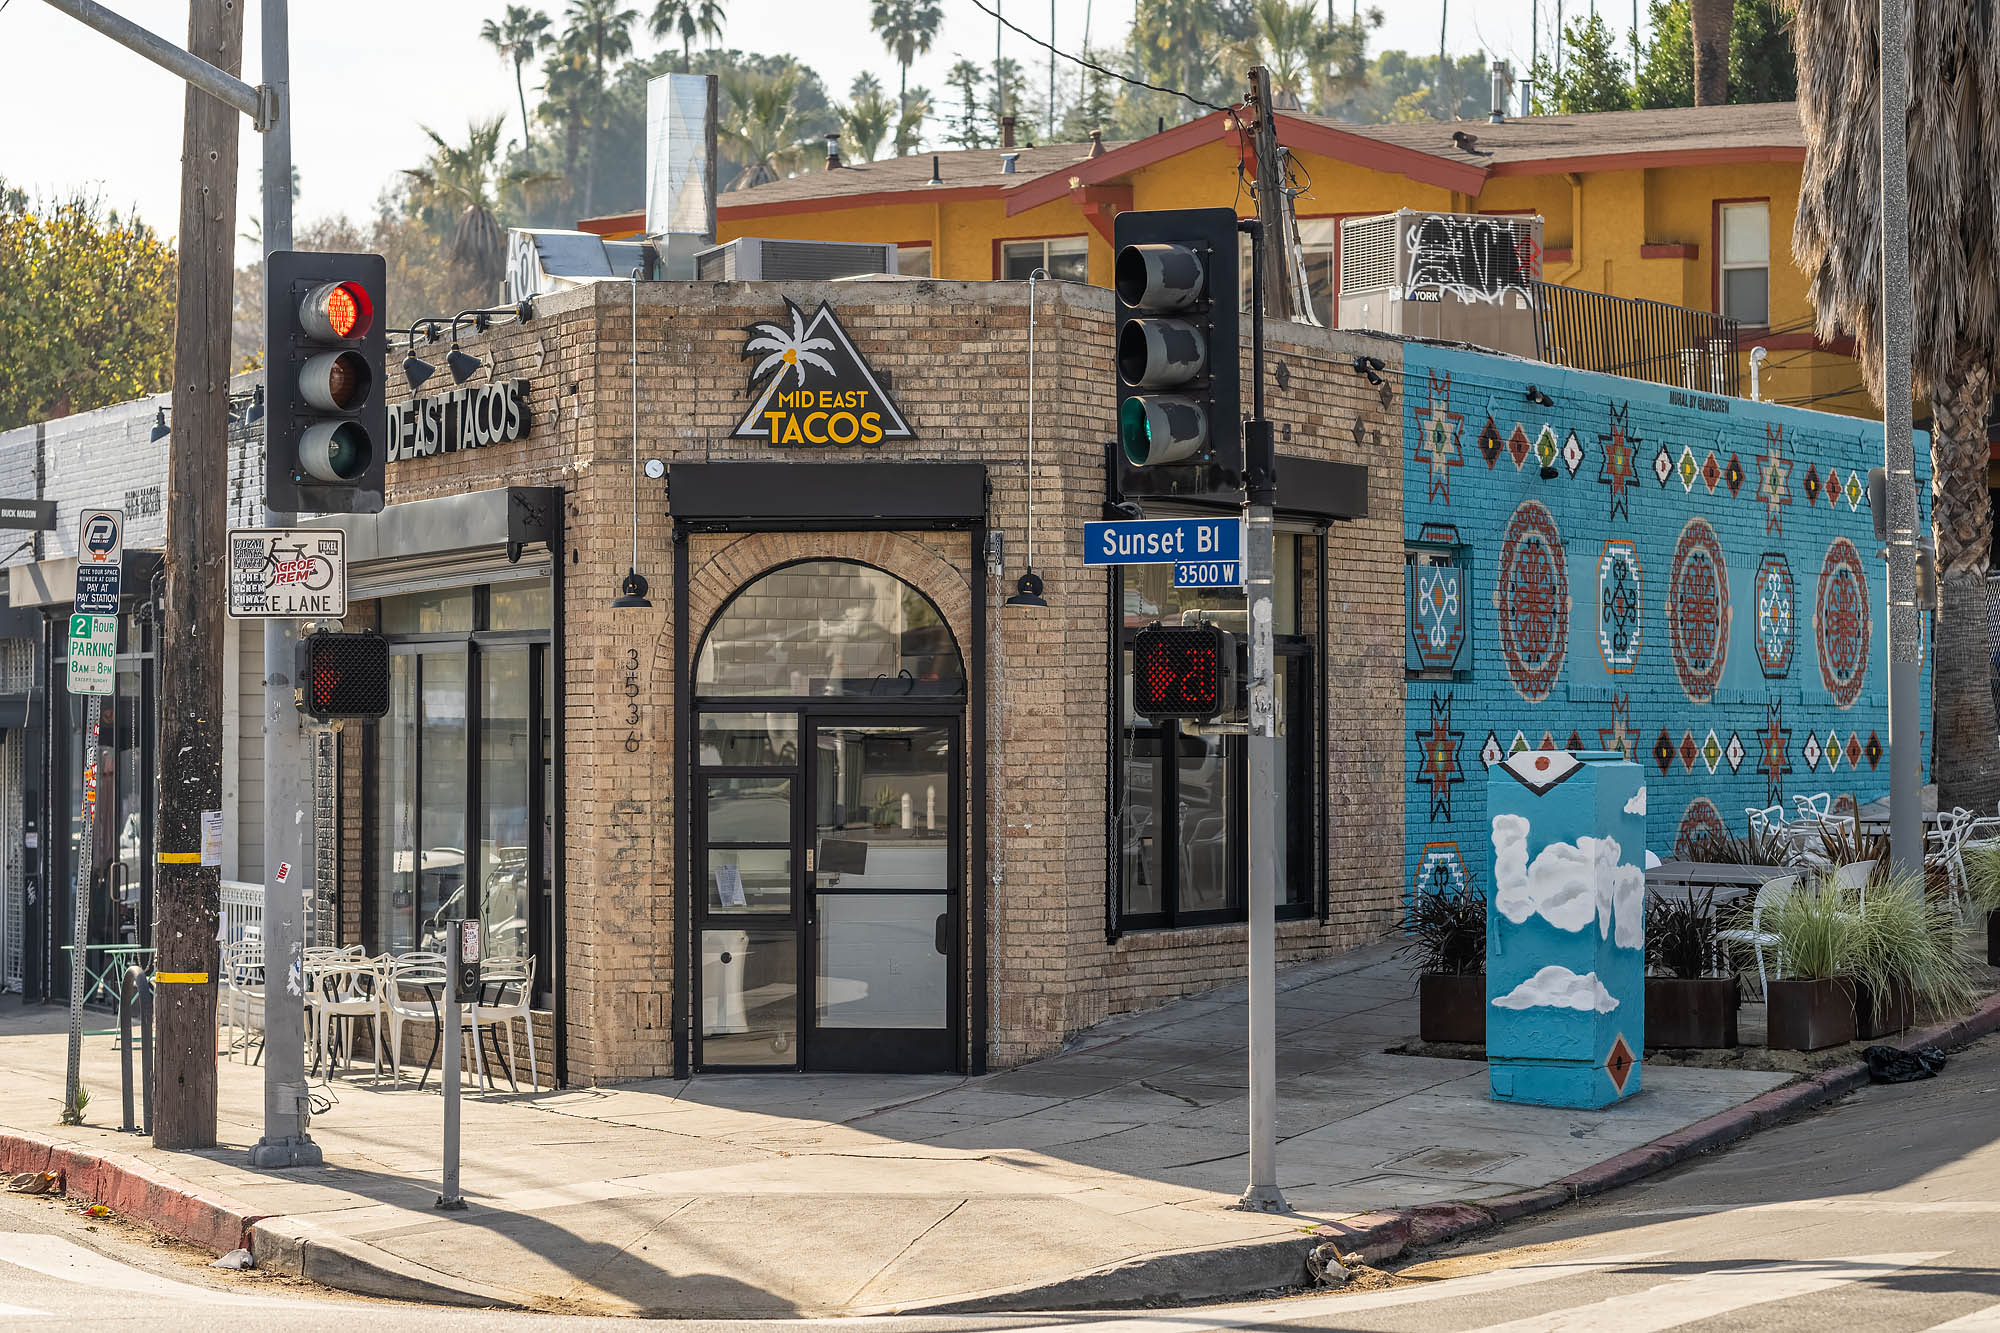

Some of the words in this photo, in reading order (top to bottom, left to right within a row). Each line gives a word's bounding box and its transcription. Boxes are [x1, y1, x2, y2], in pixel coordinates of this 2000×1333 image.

[1414, 291, 1439, 301] YORK
[778, 390, 815, 408] MID
[819, 390, 869, 408] EAST
[1669, 390, 1688, 407] MURAL
[1689, 395, 1697, 409] BY
[454, 377, 520, 449] TACOS
[764, 411, 883, 444] TACOS
[1, 509, 16, 518] BUCK
[16, 509, 37, 519] MASON
[320, 541, 338, 551] TEXEL
[1103, 526, 1185, 556] Sunset
[1197, 525, 1219, 553] Bl
[234, 573, 266, 582] APHEX
[1179, 564, 1219, 584] 3500
[1223, 563, 1235, 583] W
[87, 583, 99, 592] PAY
[100, 584, 109, 593] AT
[233, 583, 265, 593] SCREM
[77, 594, 89, 602] PAY
[91, 594, 118, 603] STATION
[289, 596, 331, 611] LANE
[75, 618, 86, 635] 2
[93, 622, 114, 633] HOUR
[71, 641, 114, 658] PARKING
[71, 660, 89, 673] 8AM
[97, 661, 112, 675] 8PM
[625, 648, 640, 753] 3536
